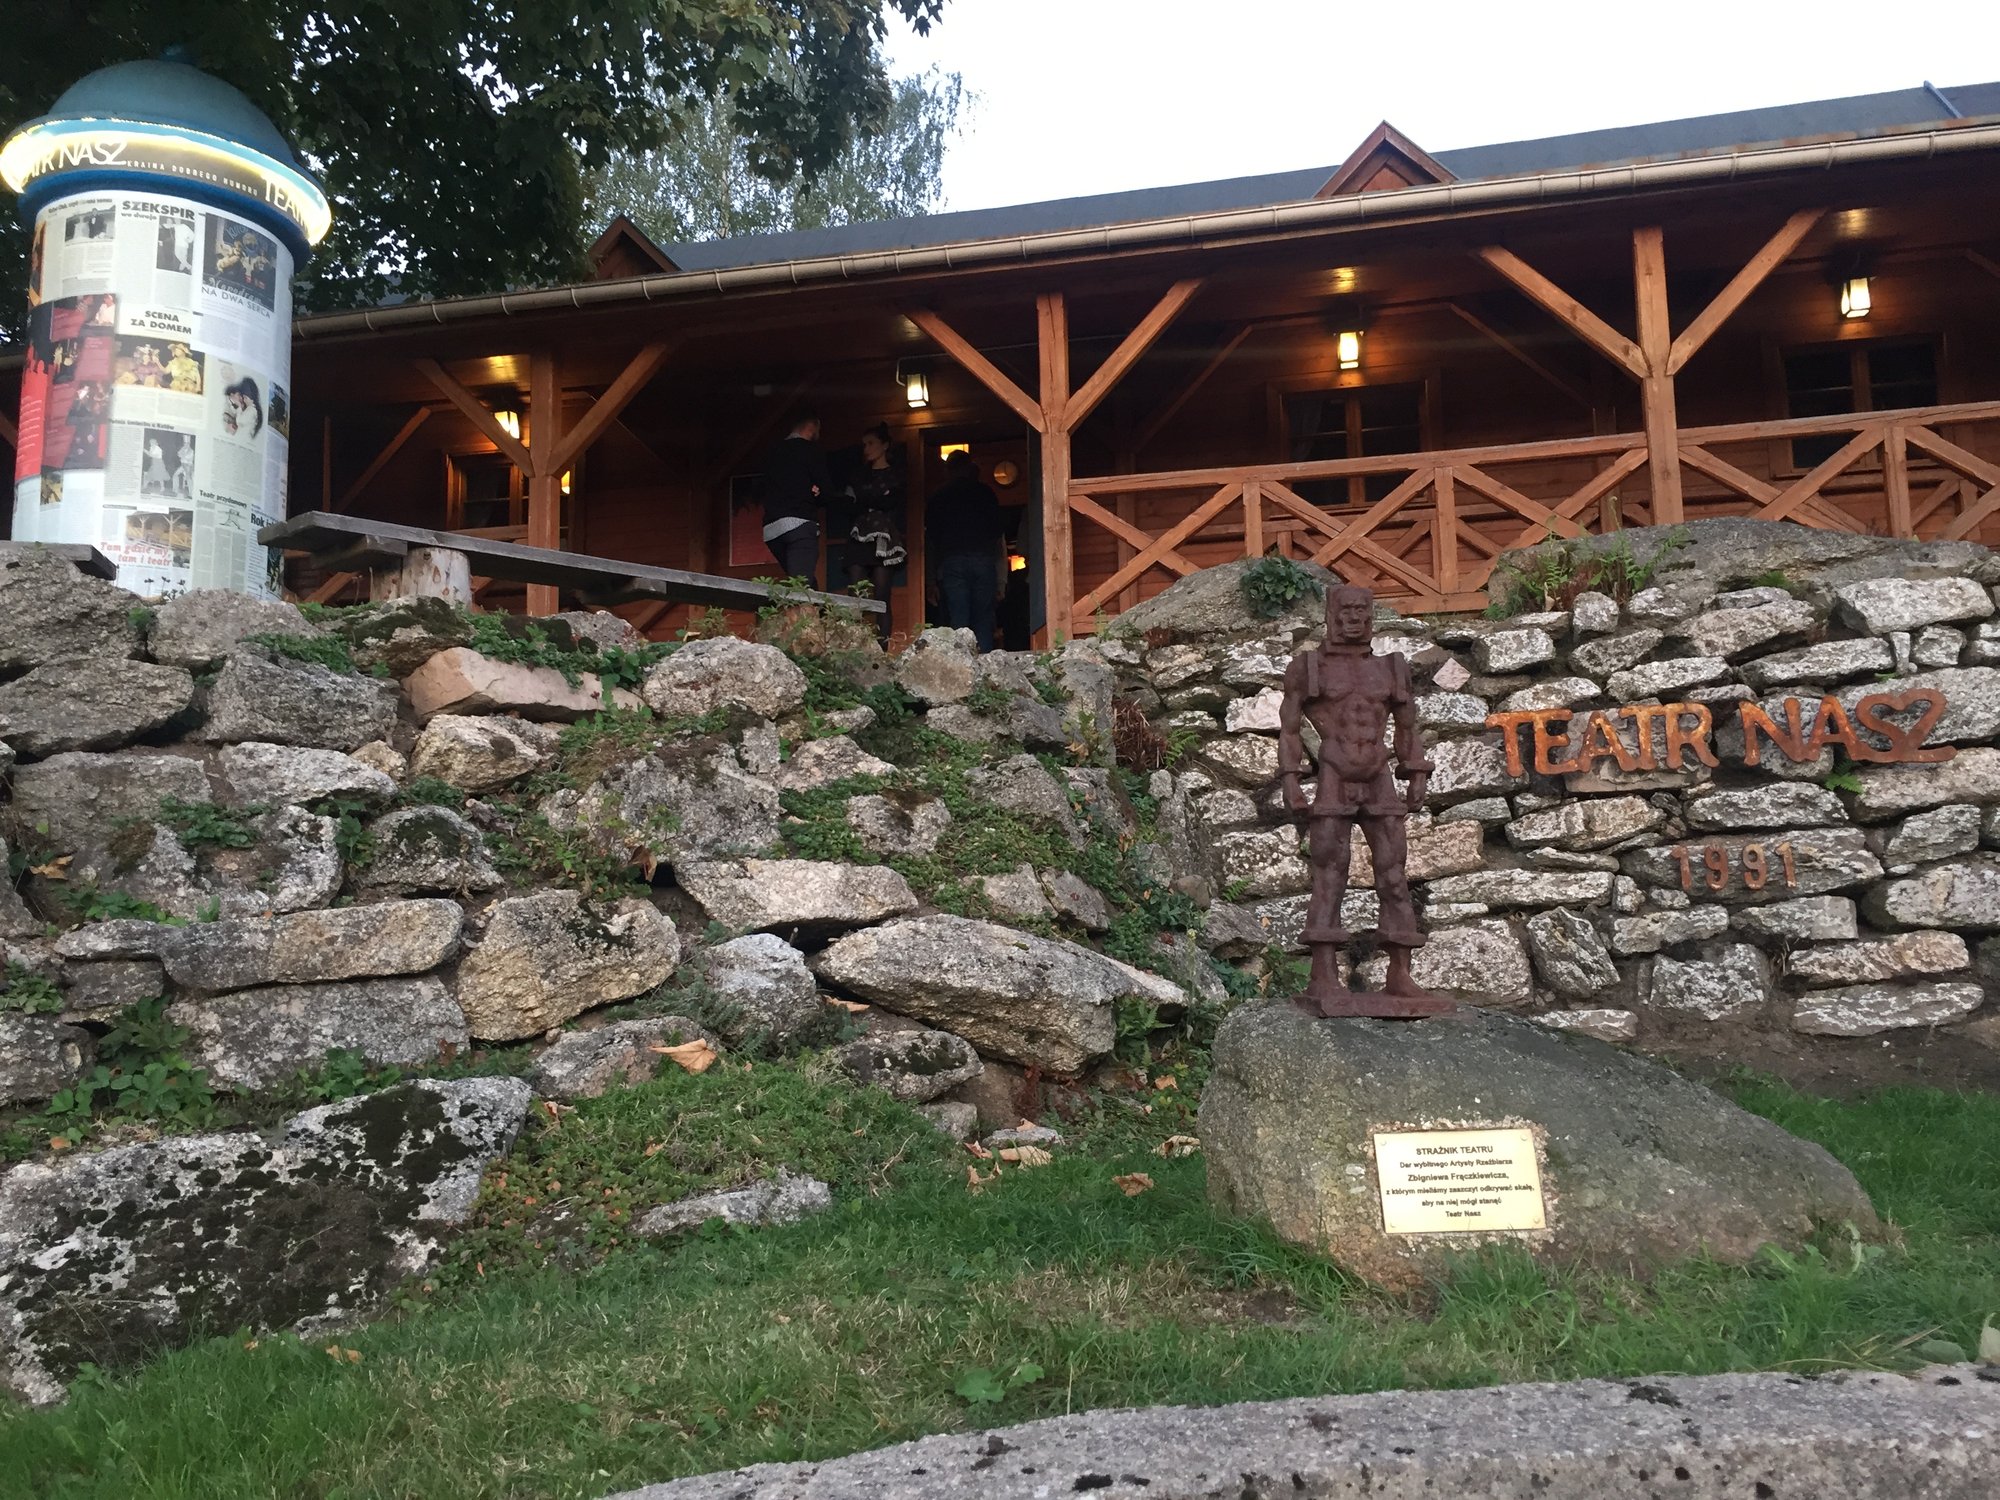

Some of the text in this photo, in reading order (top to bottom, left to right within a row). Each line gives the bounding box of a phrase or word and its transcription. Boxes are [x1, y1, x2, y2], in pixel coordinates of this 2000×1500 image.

[126, 160, 165, 171] KRAINA
[172, 165, 217, 182] DOBREGO
[122, 200, 195, 221] SZEKSPIR
[201, 286, 217, 297] NA
[221, 290, 244, 306] DWA
[145, 310, 180, 323] SCENA
[130, 318, 192, 335] ZA DOMEM
[100, 541, 121, 551] Tam
[118, 554, 137, 563] tam
[147, 556, 171, 567] teatr
[1485, 702, 1720, 778] TEATR
[1671, 842, 1797, 891] 1991
[1416, 1146, 1493, 1155] STRAŻNIK TEATRU
[1407, 1173, 1449, 1183] Zbigniewa
[1391, 1188, 1415, 1196] którym
